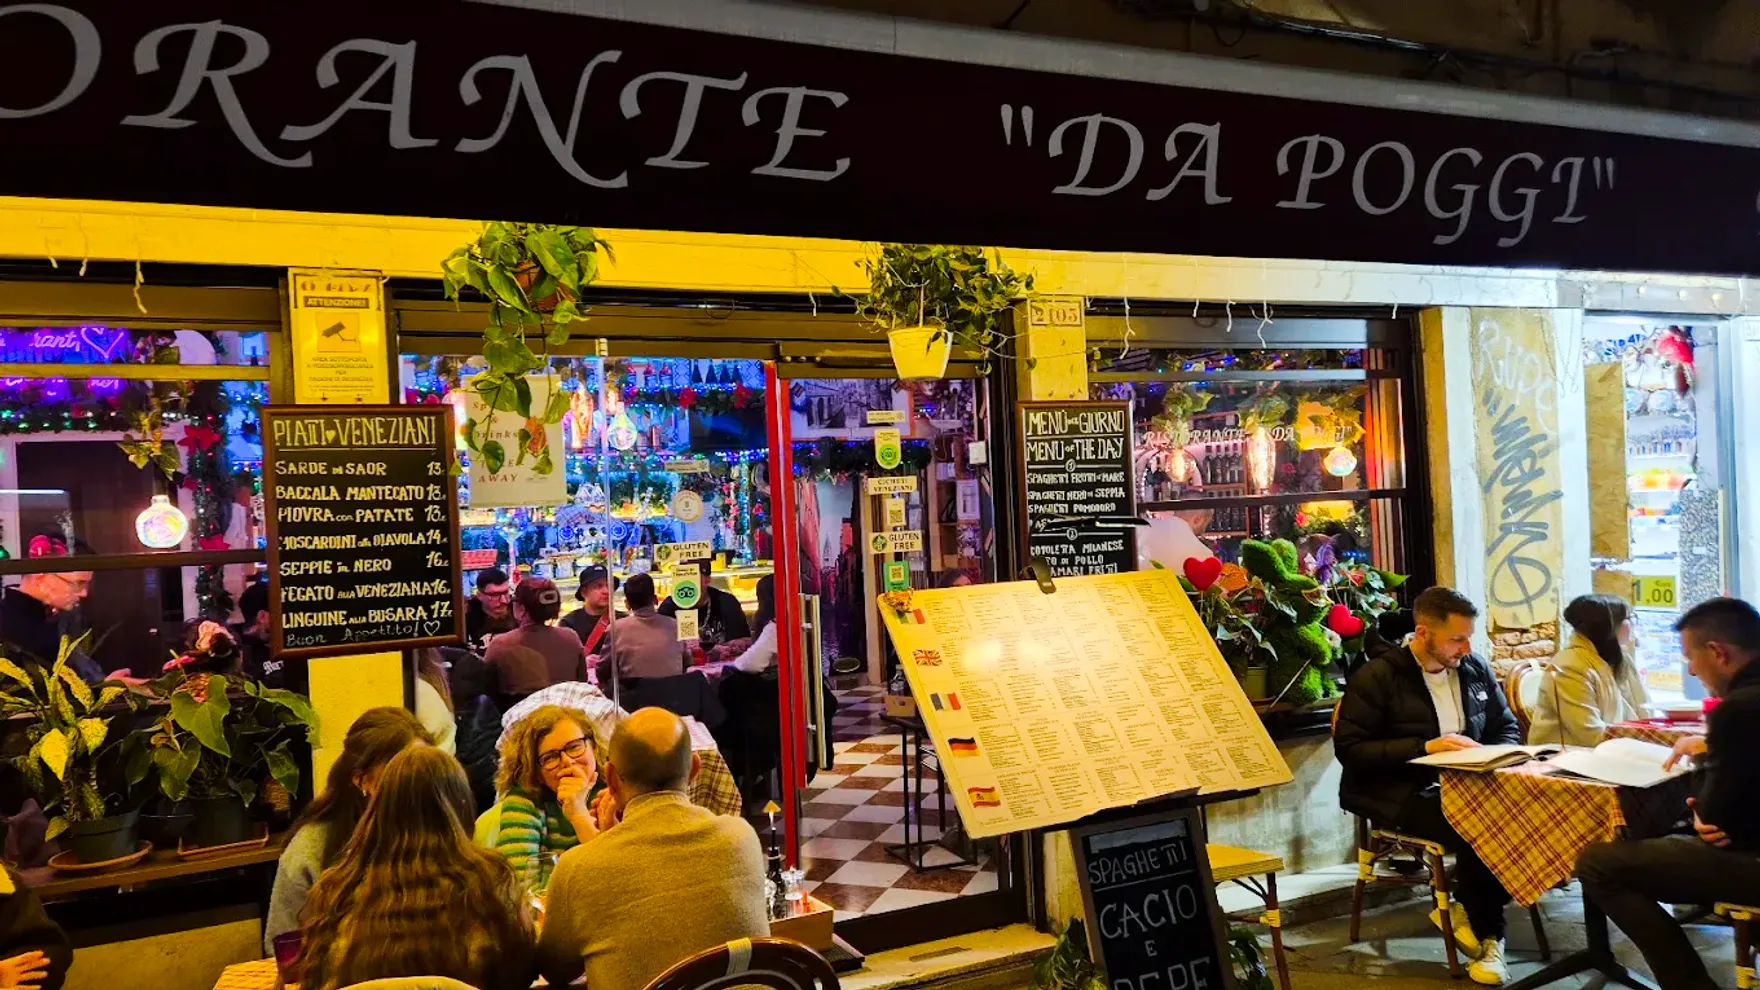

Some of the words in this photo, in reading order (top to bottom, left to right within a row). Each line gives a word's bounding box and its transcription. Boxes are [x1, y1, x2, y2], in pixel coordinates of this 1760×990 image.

[1275, 133, 1616, 248] POGGI"
[273, 418, 327, 446] PIATTI
[334, 416, 437, 446] VENEZIANI
[1027, 441, 1065, 461] MENU
[1073, 438, 1096, 460] THE
[1097, 438, 1124, 460] DAY
[275, 461, 327, 476] SARDE
[345, 462, 387, 476] SAOR
[478, 473, 518, 483] AWAY
[275, 486, 341, 501] BACCALA
[345, 485, 424, 501] MANTECATO
[277, 506, 334, 522] PIOVRA
[355, 507, 414, 522] PATATE
[889, 532, 919, 541] GLUTEN
[672, 542, 709, 551] GLUTEN
[895, 541, 914, 550] FREE
[280, 560, 332, 576] SEPPIE
[353, 558, 392, 573] NERO
[1075, 554, 1104, 565] POLLO
[1050, 565, 1084, 577] AMARI
[355, 581, 432, 598] VENEZIANA
[282, 611, 347, 629] LINGUINE
[368, 606, 428, 623] BUSARA
[1088, 840, 1188, 885] SPAGHETTI
[1099, 884, 1198, 940] CACIO
[1144, 940, 1158, 957] E
[1113, 956, 1211, 990] PE
